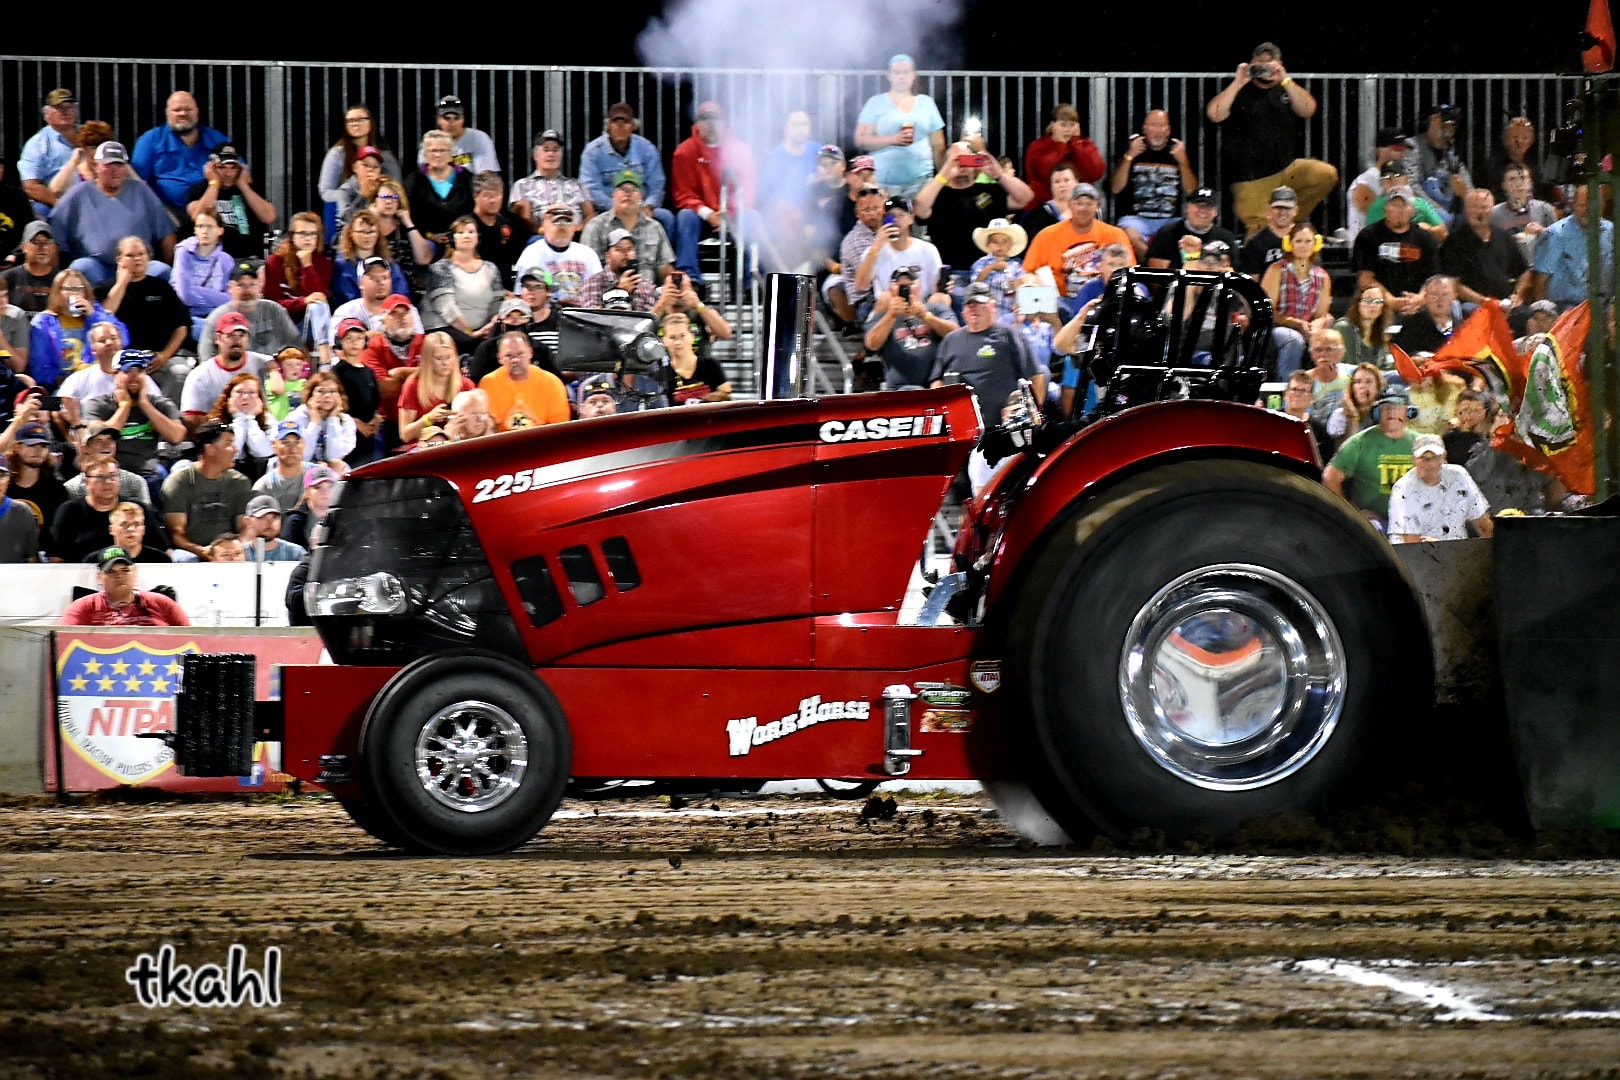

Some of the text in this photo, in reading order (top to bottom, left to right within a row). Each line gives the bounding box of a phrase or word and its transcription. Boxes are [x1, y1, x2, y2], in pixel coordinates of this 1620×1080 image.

[819, 416, 913, 443] CASE
[472, 470, 532, 503] 225
[87, 700, 174, 737] NTPA
[79, 738, 114, 767] TRACTOR
[116, 760, 154, 776] PULLERS
